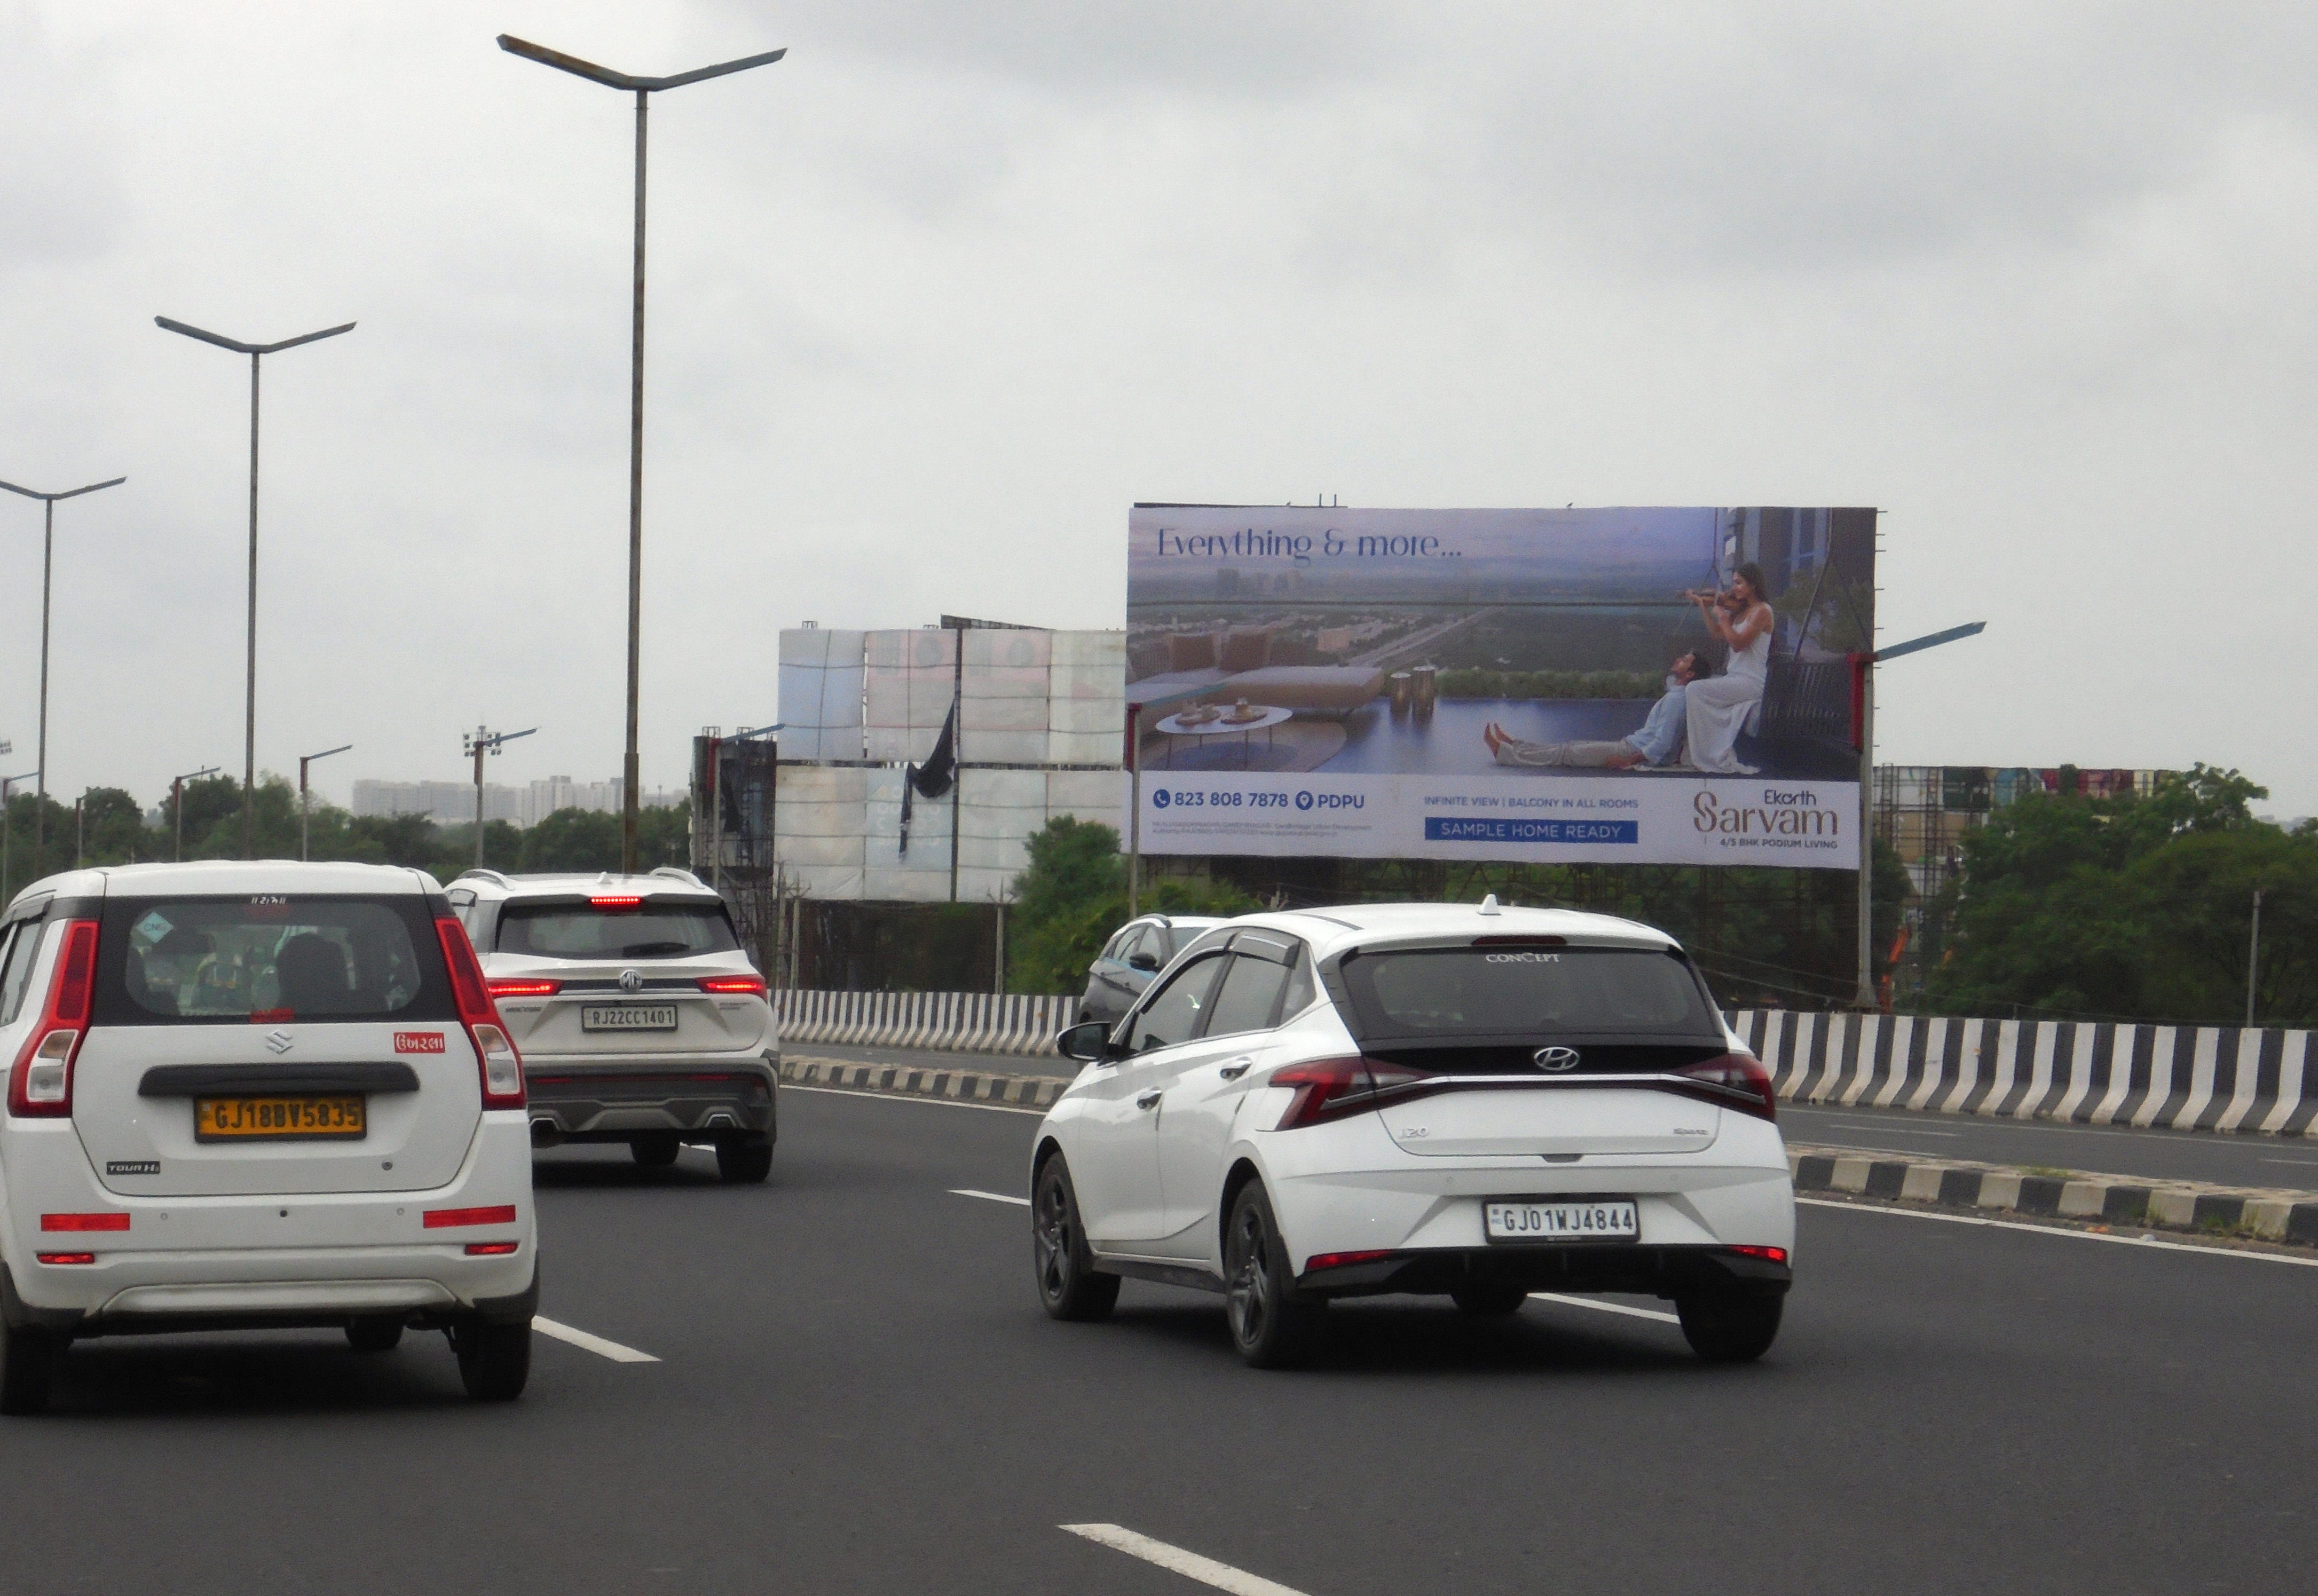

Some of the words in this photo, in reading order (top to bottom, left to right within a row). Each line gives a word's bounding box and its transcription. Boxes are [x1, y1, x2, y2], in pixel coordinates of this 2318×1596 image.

[1158, 527, 1313, 567] Everything
[1324, 528, 1345, 557] &
[1358, 534, 1462, 556] more...
[1174, 792, 1204, 806] 823
[1210, 792, 1242, 807] 808
[1248, 793, 1288, 808] 7878
[1317, 794, 1365, 809] PDPU
[1424, 796, 1468, 806] INFINITE
[1471, 797, 1498, 807] VIEW
[1509, 798, 1559, 808] BALCONY
[1562, 799, 1573, 808] IN
[1576, 799, 1596, 808] ALL
[1599, 800, 1638, 809] ROOMS
[1693, 791, 1838, 835] Sarvam
[1441, 823, 1505, 837] SAMPLE
[1512, 824, 1559, 837] HOME
[1565, 825, 1622, 839] READY
[1739, 839, 1760, 847] BHK
[1762, 839, 1801, 848] PODIUM
[1804, 840, 1838, 849] LIVING
[1486, 952, 1559, 962] CONCEPT
[593, 1010, 672, 1025] RJ22CC1401
[1503, 1208, 1634, 1231] GJ01WJ4844
